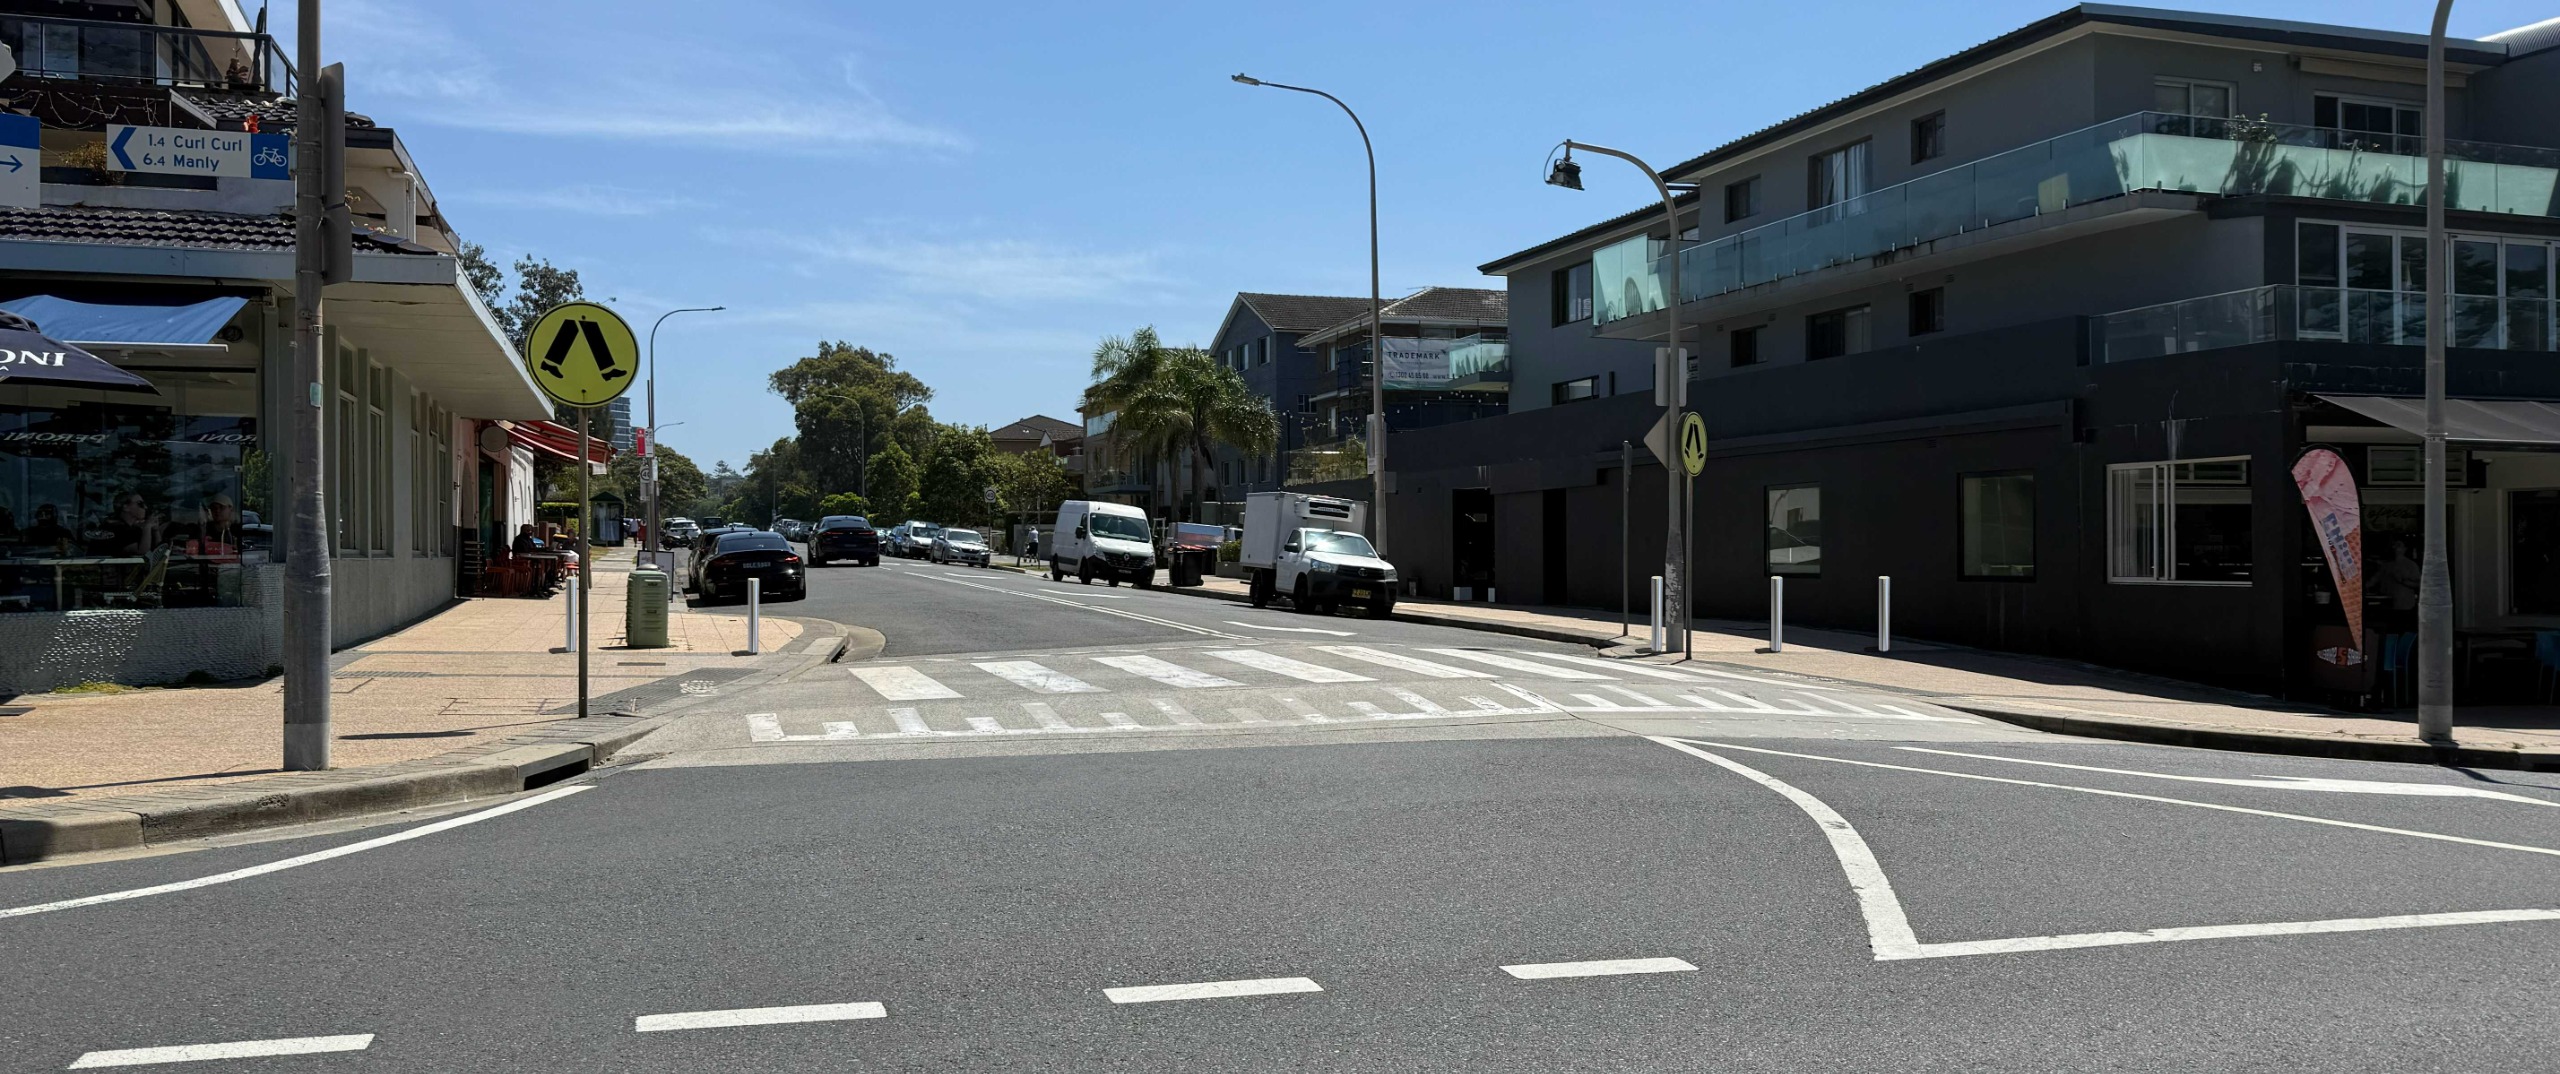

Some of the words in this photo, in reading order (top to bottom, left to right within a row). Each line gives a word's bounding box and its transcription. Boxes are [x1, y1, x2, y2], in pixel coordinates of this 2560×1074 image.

[148, 134, 165, 147] 1.4
[173, 135, 205, 150] Curl
[211, 137, 242, 152] Curl
[143, 152, 165, 166] 6.4
[173, 154, 220, 172] Manly
[1387, 351, 1440, 360] TRADEMARK
